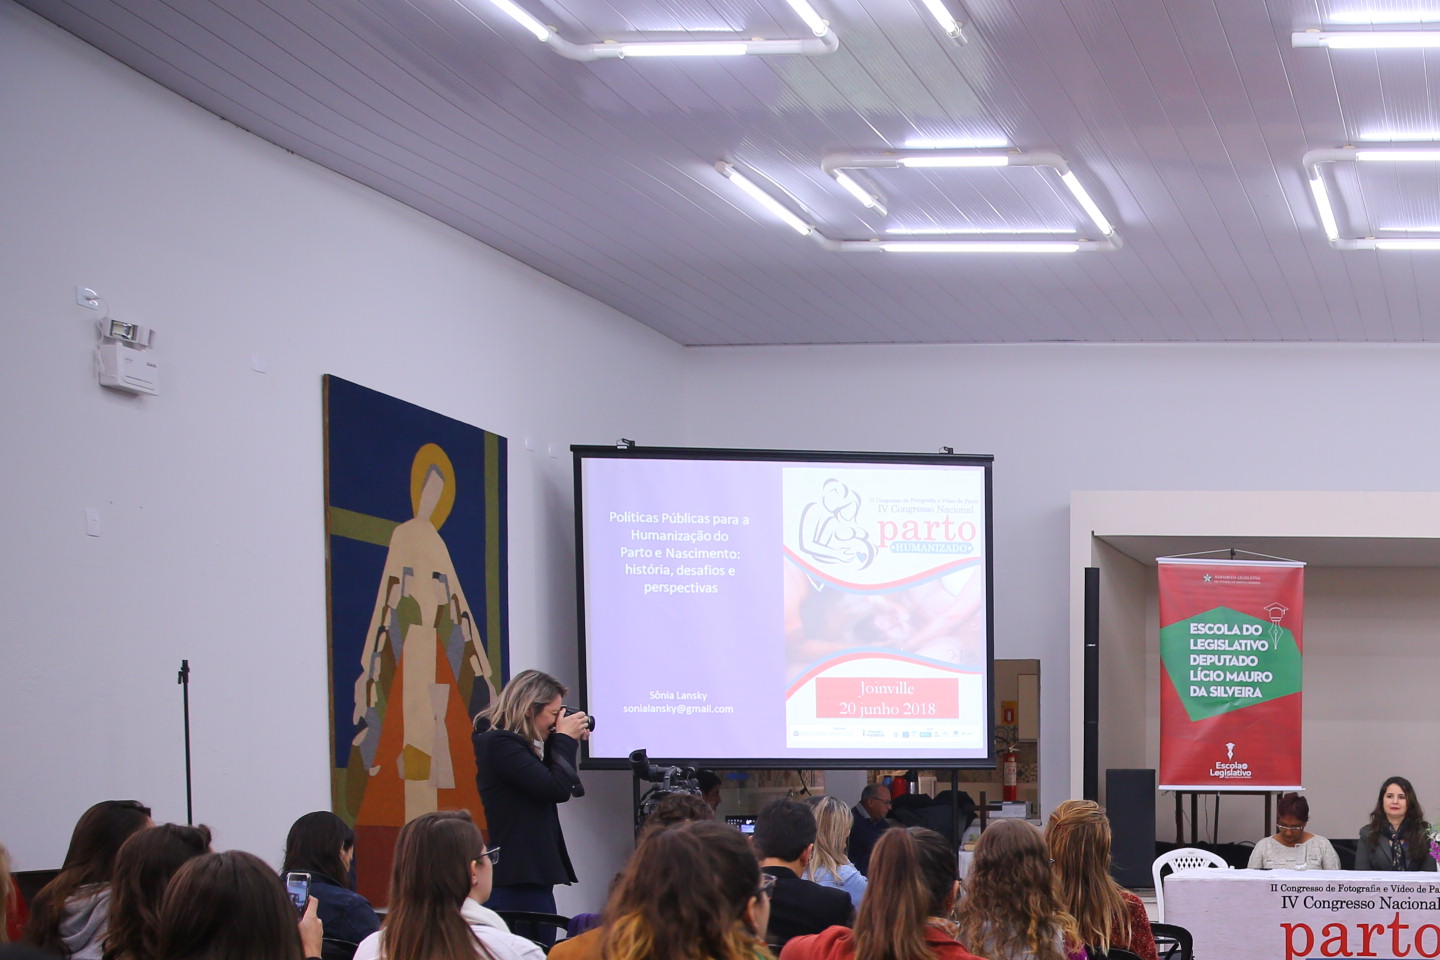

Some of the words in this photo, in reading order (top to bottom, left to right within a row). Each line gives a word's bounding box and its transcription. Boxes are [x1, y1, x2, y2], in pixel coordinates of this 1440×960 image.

[878, 505, 888, 513] IV
[890, 505, 935, 514] Congresso
[937, 505, 974, 514] Nacional
[609, 511, 659, 523] Políticas
[662, 512, 711, 524] Públicas
[713, 516, 739, 526] para
[742, 516, 750, 525] a
[631, 529, 711, 544] Humanização
[713, 530, 729, 542] do
[877, 514, 976, 548] parto
[620, 547, 653, 558] Parto
[655, 550, 662, 558] e
[665, 548, 741, 560] Nascimento:
[895, 543, 967, 553] HUMANIZADO
[625, 564, 674, 576] história,
[676, 565, 726, 576] desafios
[728, 567, 736, 576] e
[644, 582, 719, 595] perspectivas
[1190, 622, 1241, 635] ESCOLA
[1243, 624, 1263, 636] DO
[1190, 638, 1269, 651] LEGISLATIVO
[1190, 654, 1258, 667] DEPUTADO
[1190, 667, 1224, 682] LÍCIO
[1226, 671, 1273, 682] MAURO
[649, 690, 675, 700] Sônia
[676, 691, 708, 702] Lansky
[858, 681, 915, 698] Joinville
[1190, 685, 1208, 697] DA
[1209, 686, 1263, 698] SILVEIRA
[623, 704, 735, 715] sonialansky@gmail.com
[839, 702, 856, 715] 20
[859, 702, 900, 719] junho
[903, 702, 936, 716] 2018
[1215, 761, 1242, 770] Escola
[1210, 769, 1252, 778] Legislativo
[1280, 884, 1324, 894] Congresso
[1326, 884, 1336, 892] de
[1338, 884, 1381, 894] Fotografia
[1390, 885, 1414, 893] Vídeo
[1416, 885, 1427, 894] de
[1281, 895, 1299, 909] IV
[1303, 895, 1375, 912] Congresso
